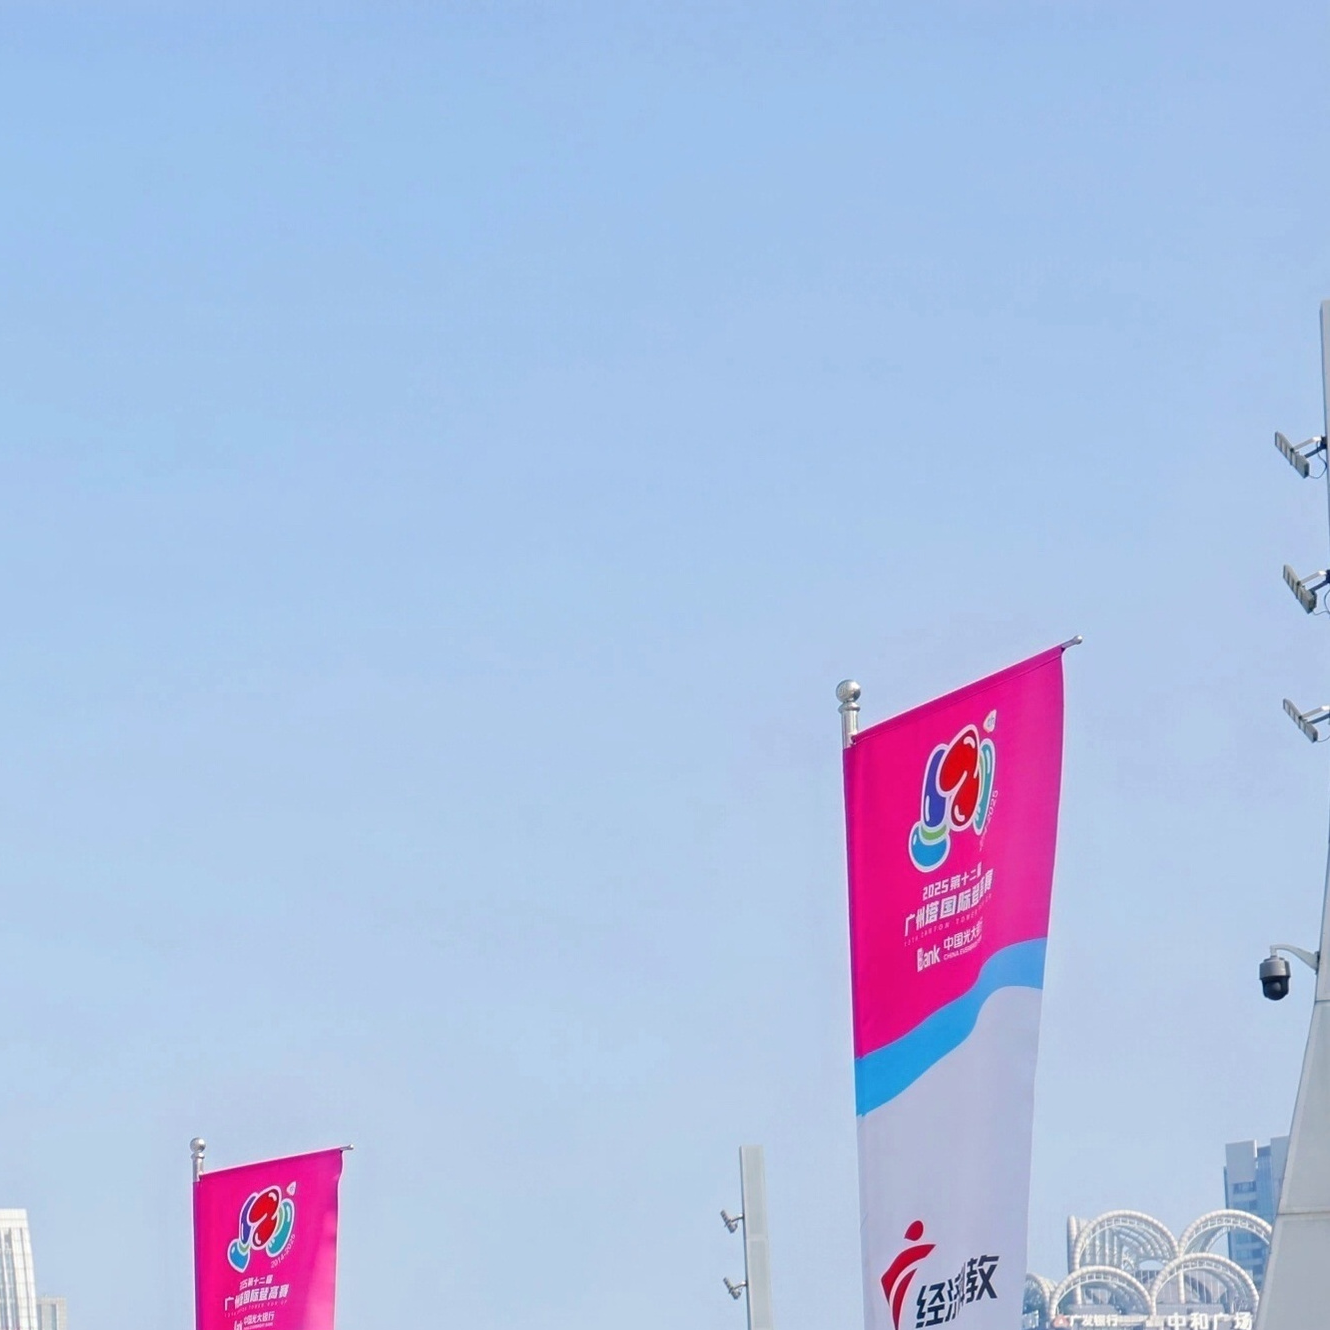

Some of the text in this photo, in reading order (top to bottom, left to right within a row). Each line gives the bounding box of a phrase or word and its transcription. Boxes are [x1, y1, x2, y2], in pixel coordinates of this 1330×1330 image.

[917, 946, 941, 972] Bank
[1070, 1314, 1118, 1328] 广发银行
